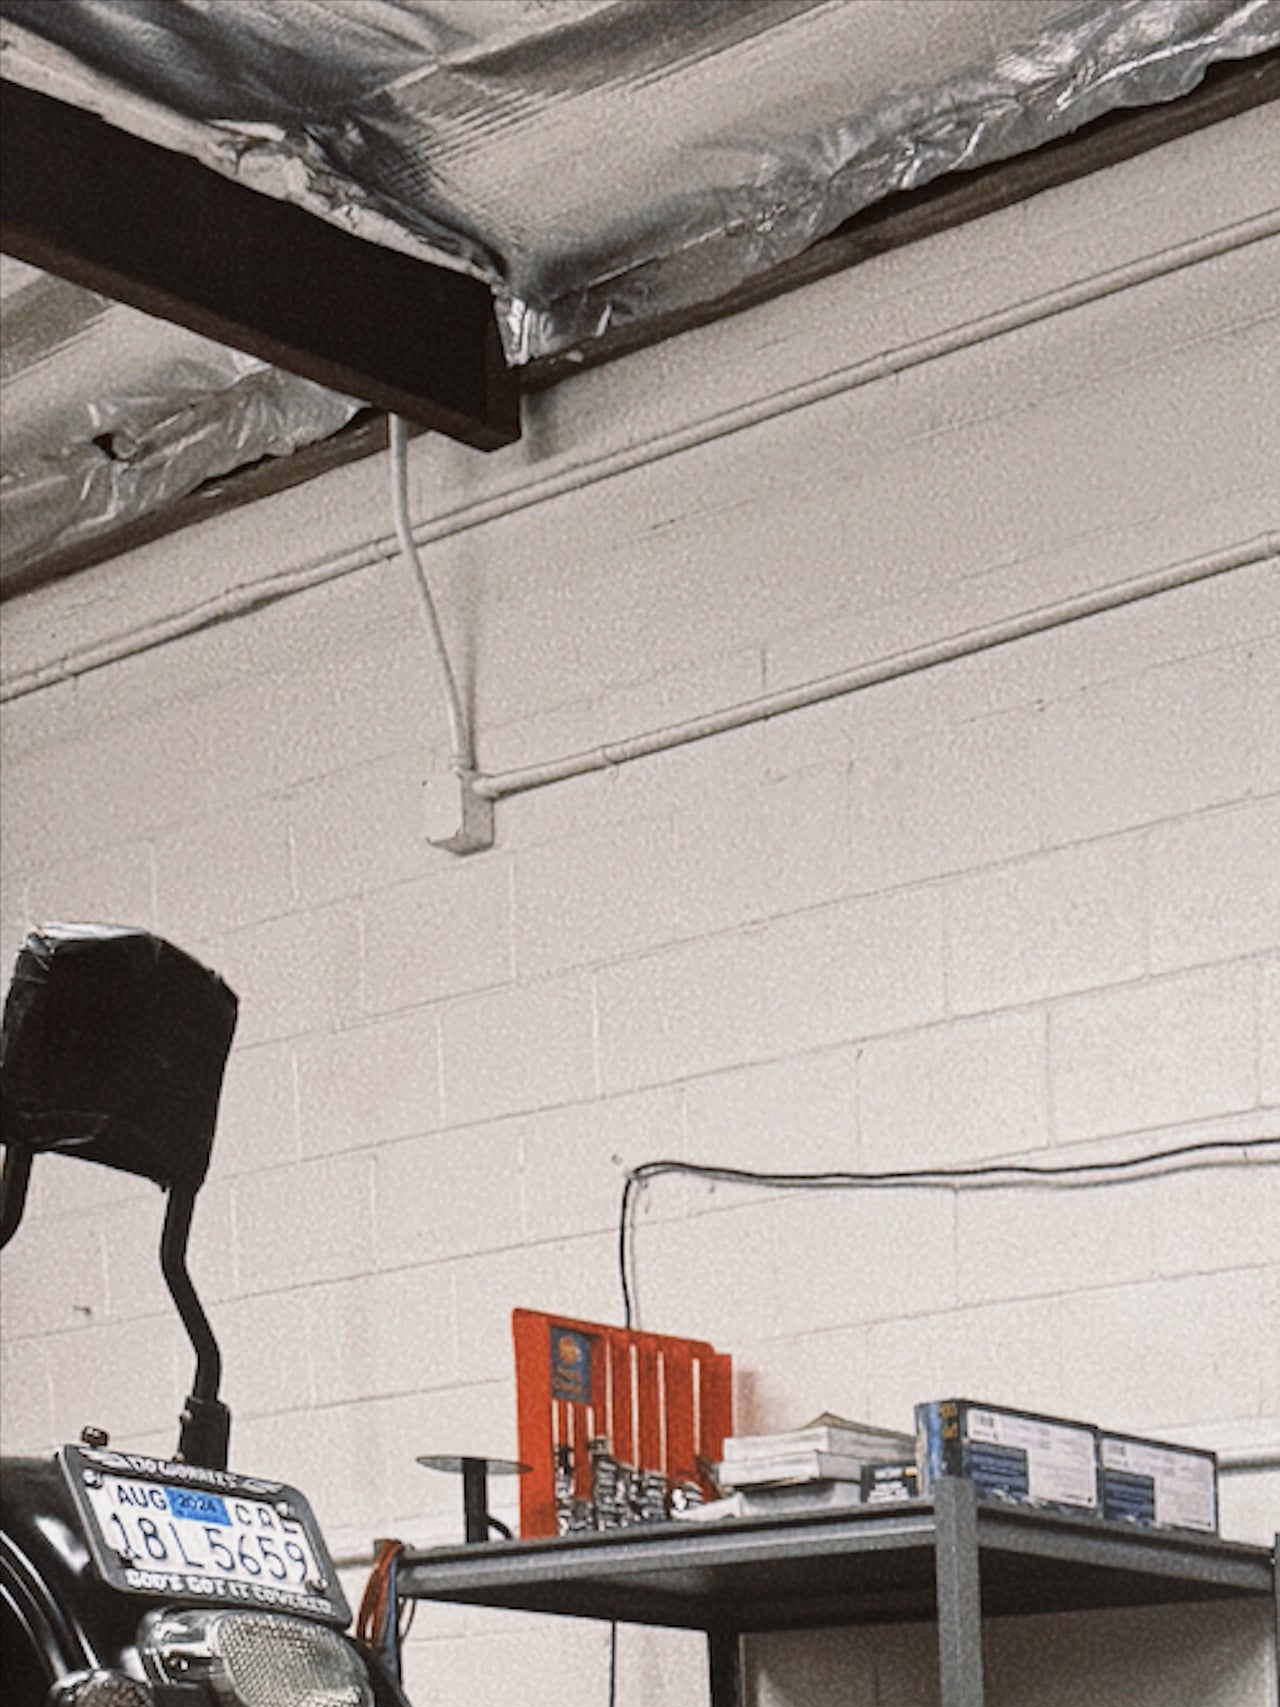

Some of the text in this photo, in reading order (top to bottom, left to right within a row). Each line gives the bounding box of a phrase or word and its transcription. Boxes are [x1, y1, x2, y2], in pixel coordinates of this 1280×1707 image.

[117, 1484, 168, 1511] AUG
[177, 1491, 217, 1513] 2024
[111, 1512, 308, 1582] 18L5659
